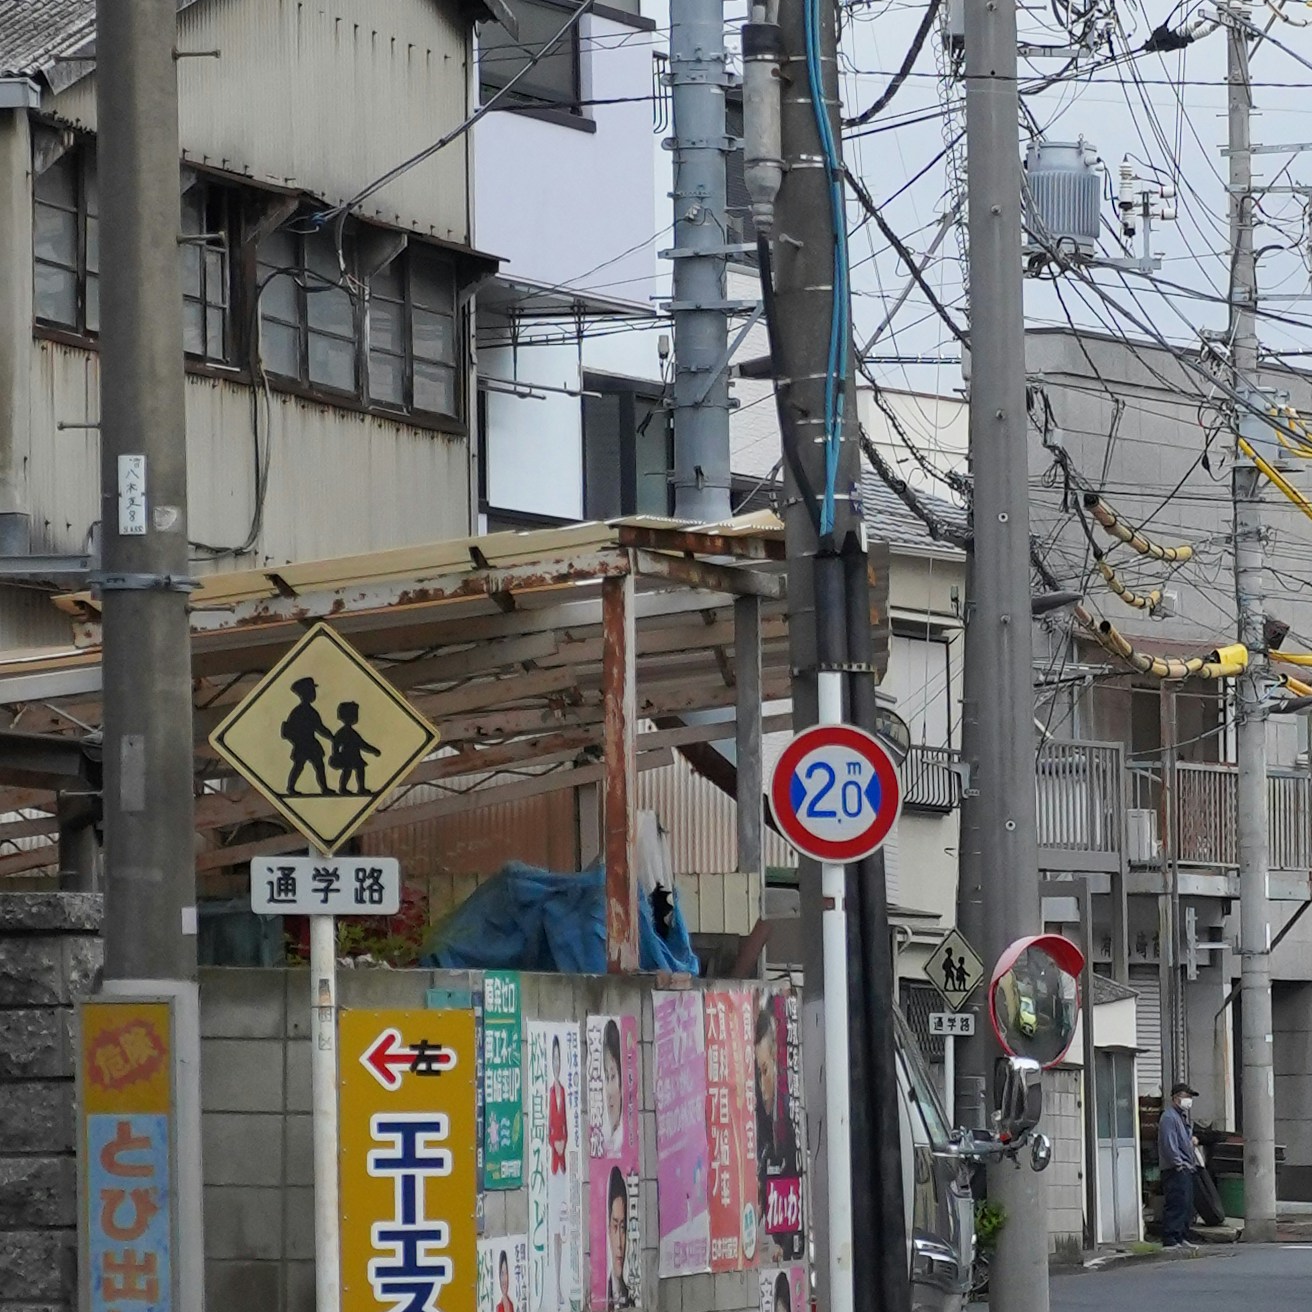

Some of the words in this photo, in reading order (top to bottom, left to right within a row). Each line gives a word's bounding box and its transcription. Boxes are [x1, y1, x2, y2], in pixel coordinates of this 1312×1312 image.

[266, 866, 386, 906] 通学路
[933, 1016, 970, 1032] 通学路
[95, 1025, 159, 1087] 危険
[409, 1039, 443, 1077] 左
[742, 1001, 755, 1161] 食の安全
[705, 1001, 721, 1198] 大幅アップ
[717, 1000, 731, 1207] 食料自給率
[528, 1030, 547, 1312] 松島みどり
[767, 1181, 797, 1229] れいわ
